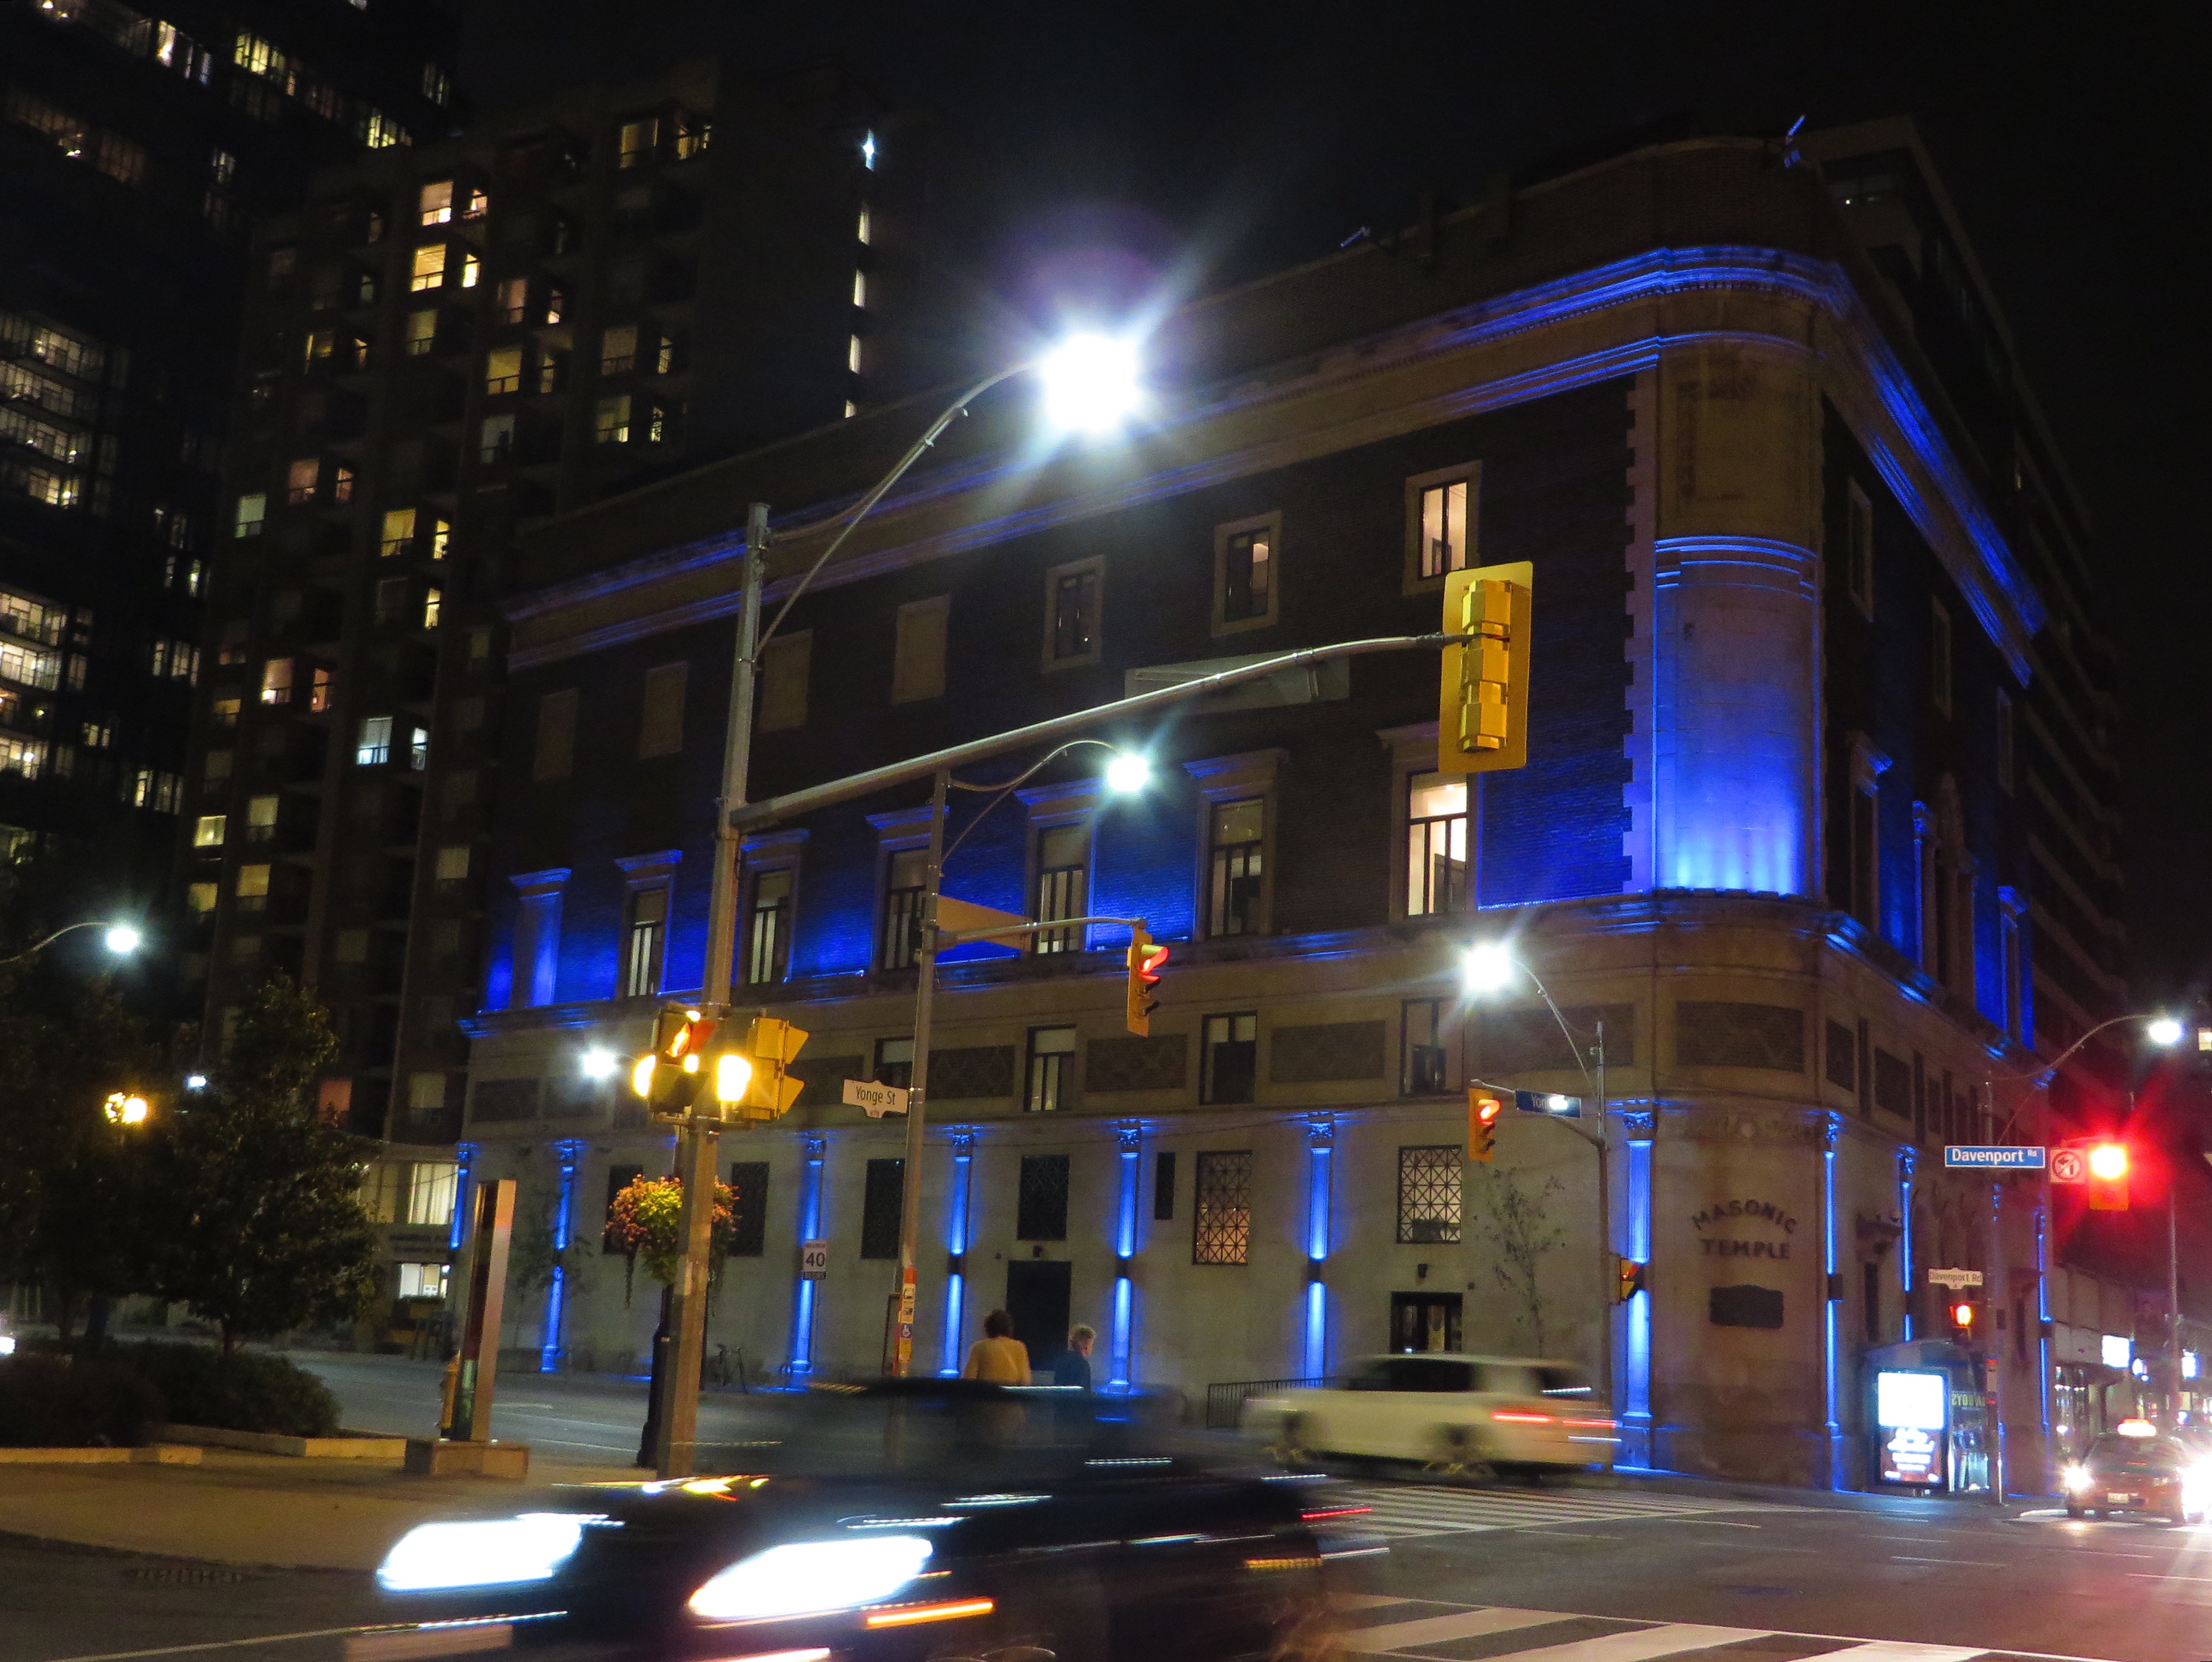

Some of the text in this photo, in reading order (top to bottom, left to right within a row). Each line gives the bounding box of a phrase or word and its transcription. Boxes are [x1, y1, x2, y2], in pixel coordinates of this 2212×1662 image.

[856, 1086, 896, 1105] Yonge St
[1952, 1148, 2025, 1165] Davenport
[1692, 1199, 1797, 1234] MASONIC
[1700, 1239, 1791, 1260] TEMPLE
[806, 1252, 825, 1267] 40
[1929, 1272, 1970, 1283] Davenport
